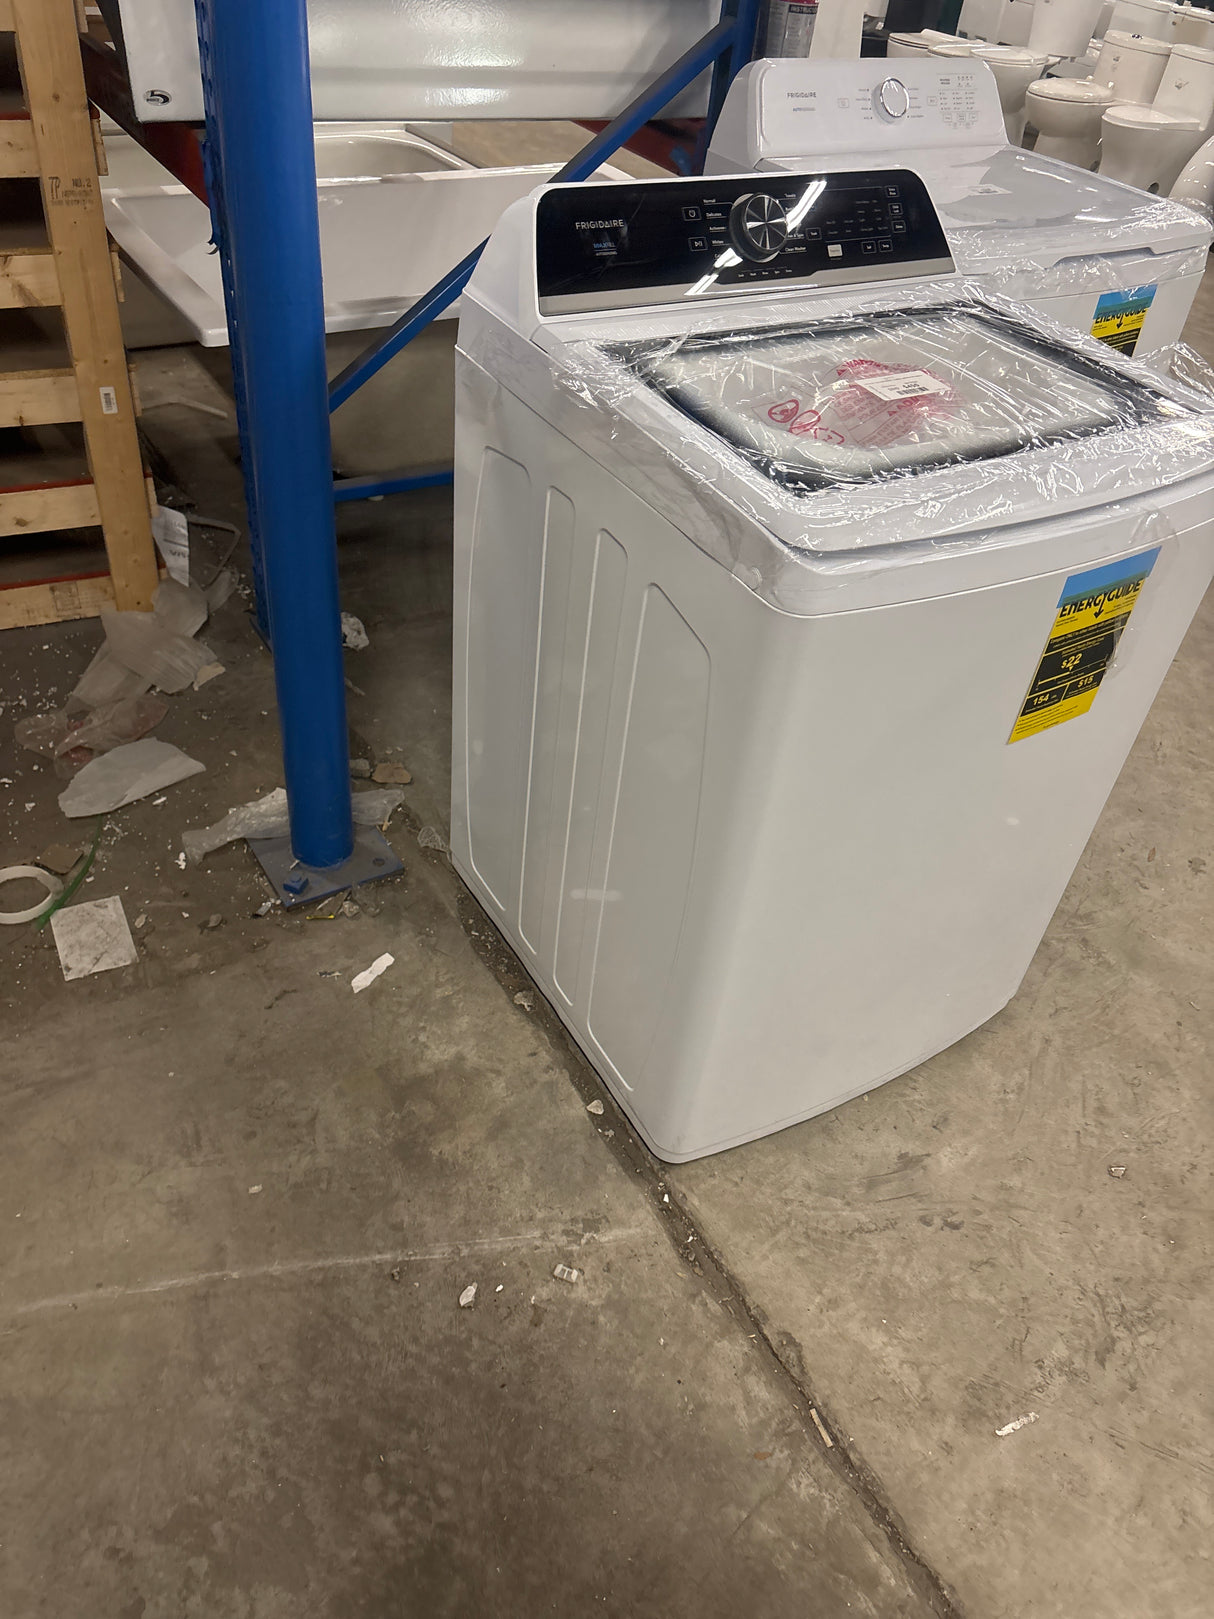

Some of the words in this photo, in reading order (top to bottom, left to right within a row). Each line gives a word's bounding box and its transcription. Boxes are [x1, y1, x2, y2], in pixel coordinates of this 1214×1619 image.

[575, 219, 625, 230] FRIGIDAIRE
[1061, 653, 1083, 669] $22
[1077, 675, 1094, 688] $15
[1033, 693, 1049, 706] 154
